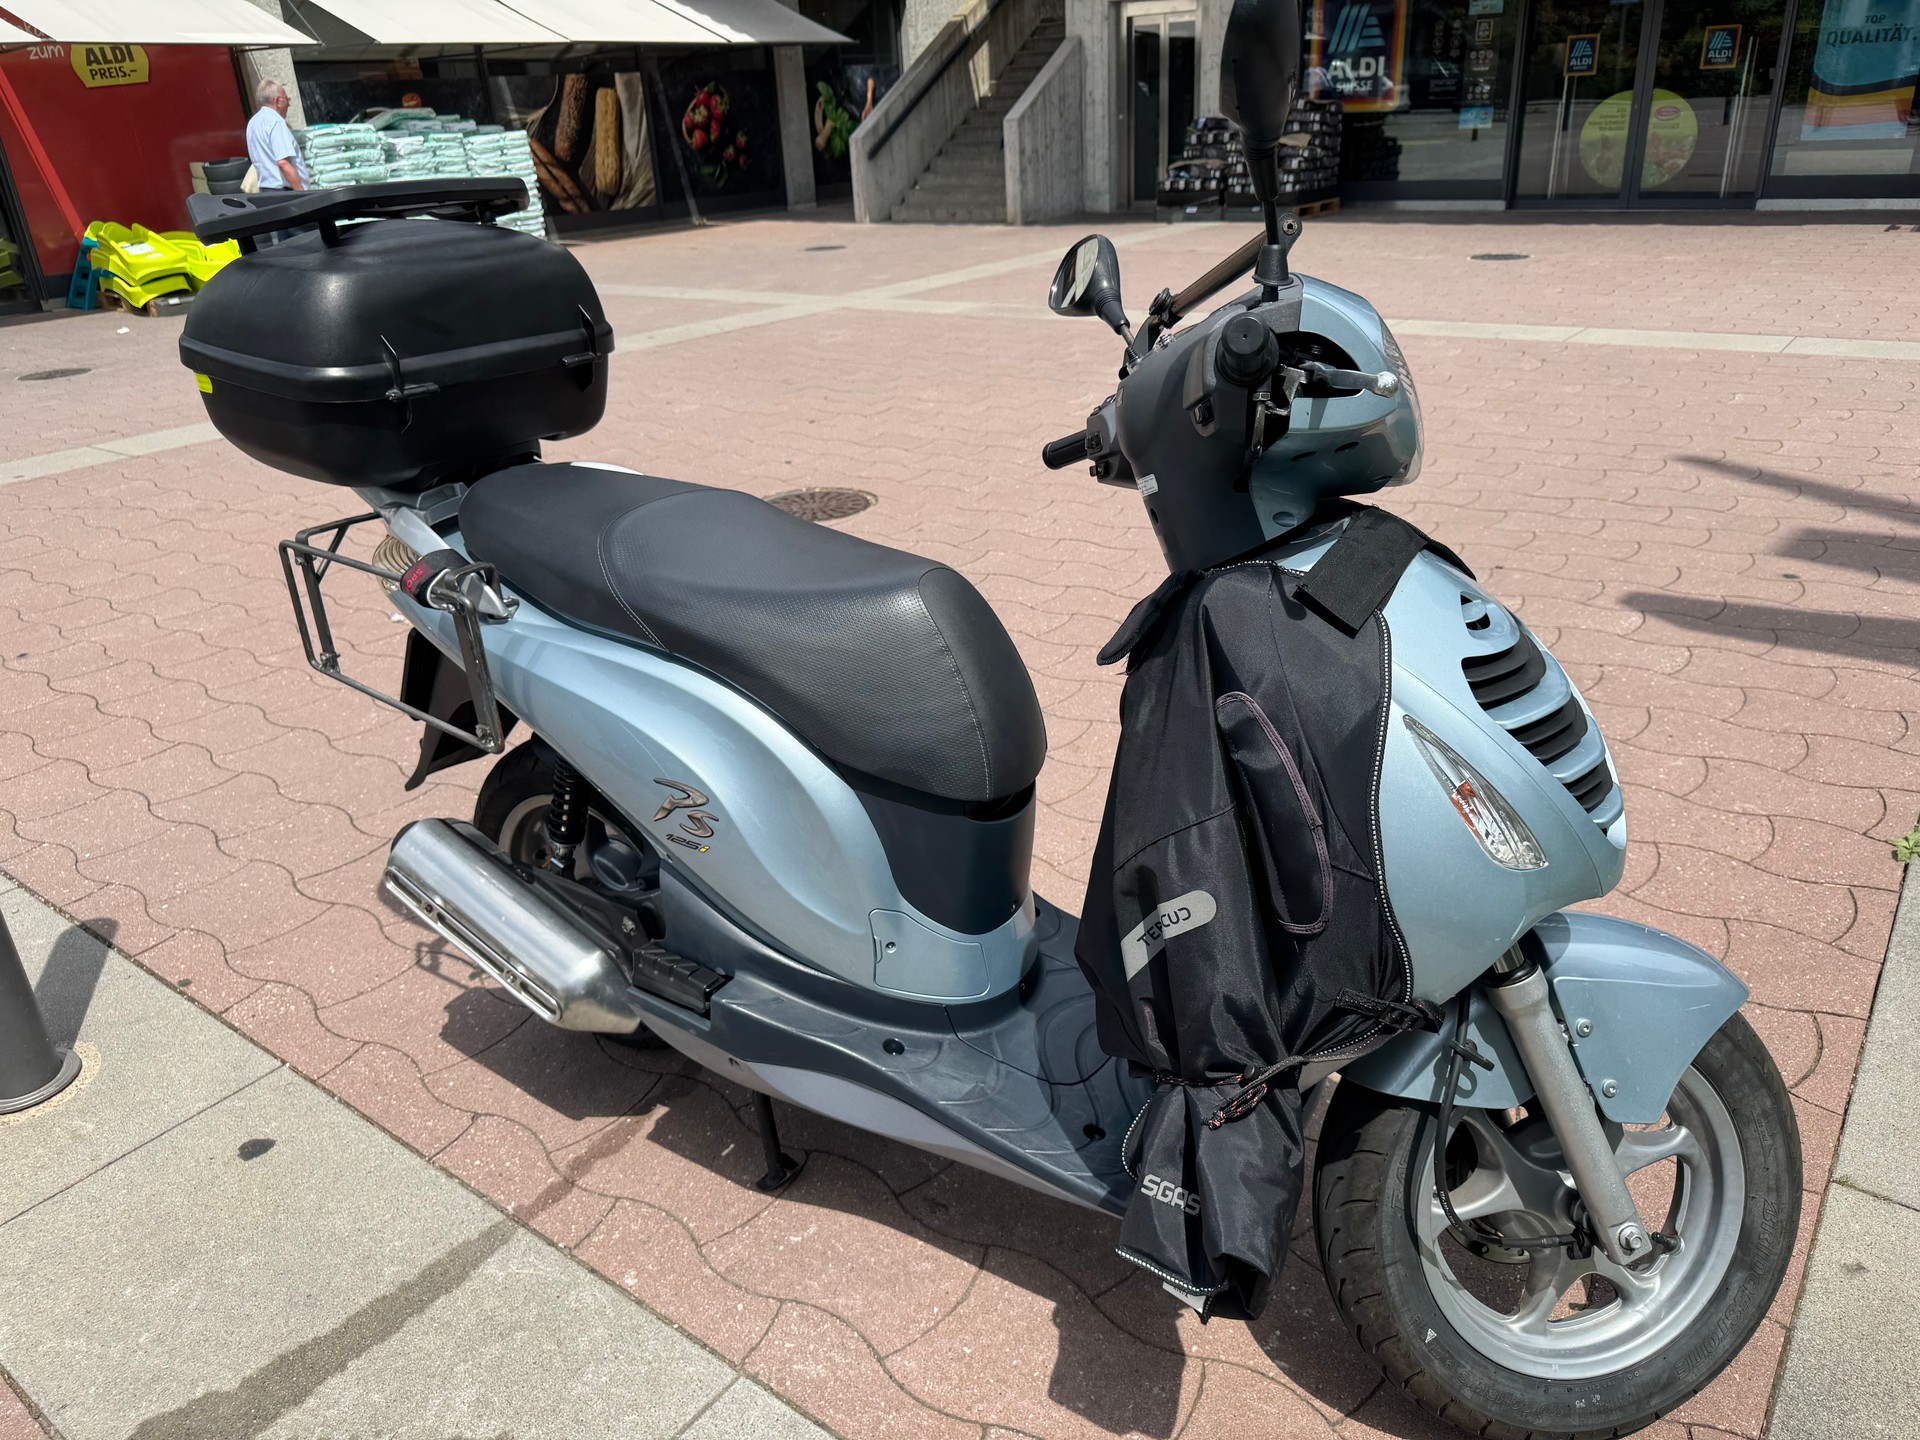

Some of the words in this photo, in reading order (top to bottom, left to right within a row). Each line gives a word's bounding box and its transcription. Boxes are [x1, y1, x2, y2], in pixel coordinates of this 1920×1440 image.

[1865, 14, 1886, 24] TOP
[1826, 23, 1917, 47] QUALITÄT.
[27, 45, 64, 60] zum
[85, 44, 135, 66] ALDI
[1708, 50, 1732, 58] ALDI
[1327, 56, 1385, 79] ALDI
[1570, 57, 1592, 66] ALDI
[666, 833, 710, 853] 125i
